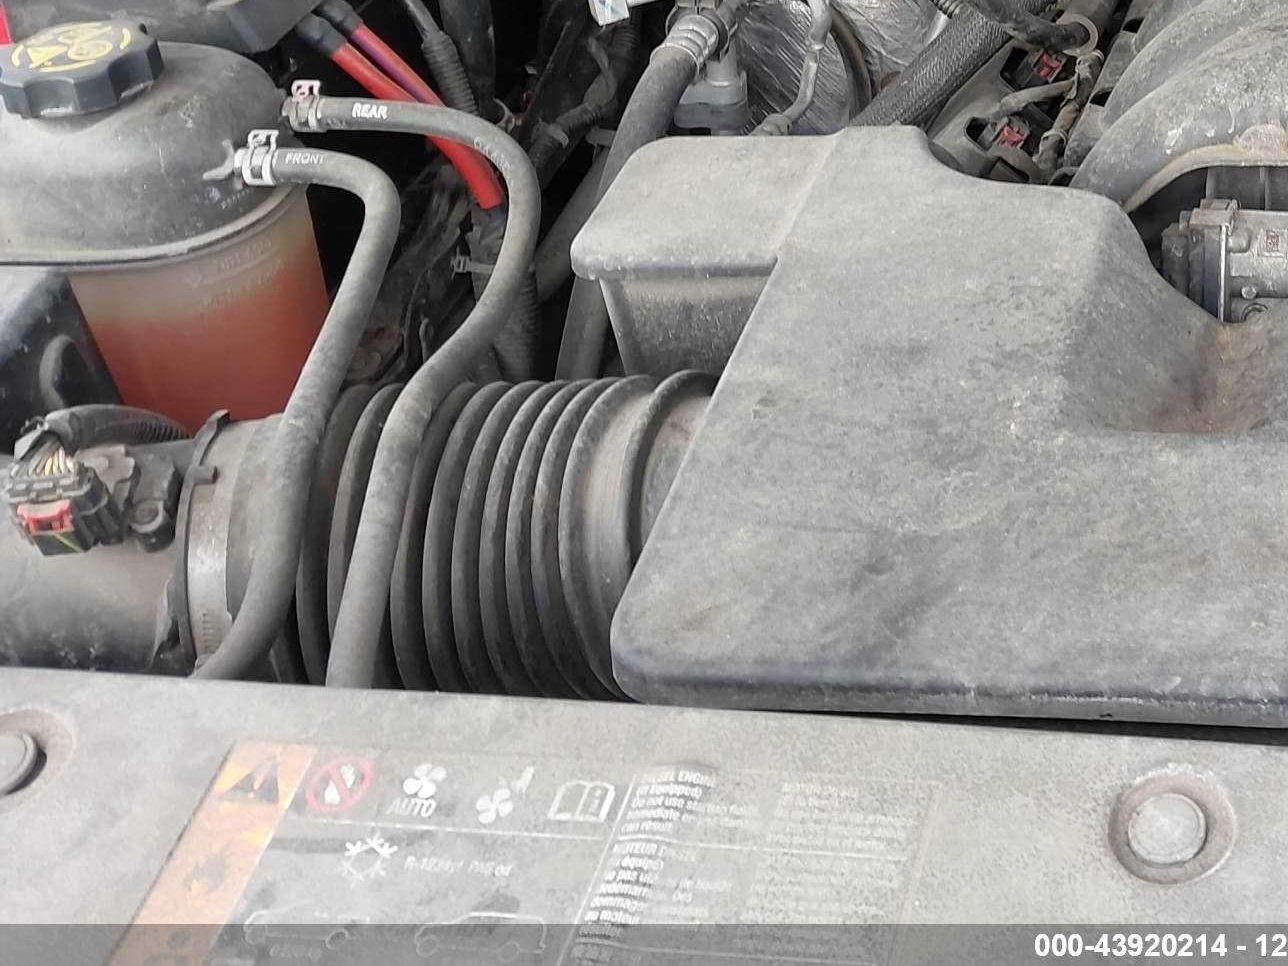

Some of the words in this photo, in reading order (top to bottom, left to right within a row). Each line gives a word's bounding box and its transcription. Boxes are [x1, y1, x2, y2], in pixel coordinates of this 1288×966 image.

[351, 102, 388, 119] REAR
[285, 153, 325, 165] FRONT
[386, 797, 436, 818] AUTO
[664, 797, 685, 809] use
